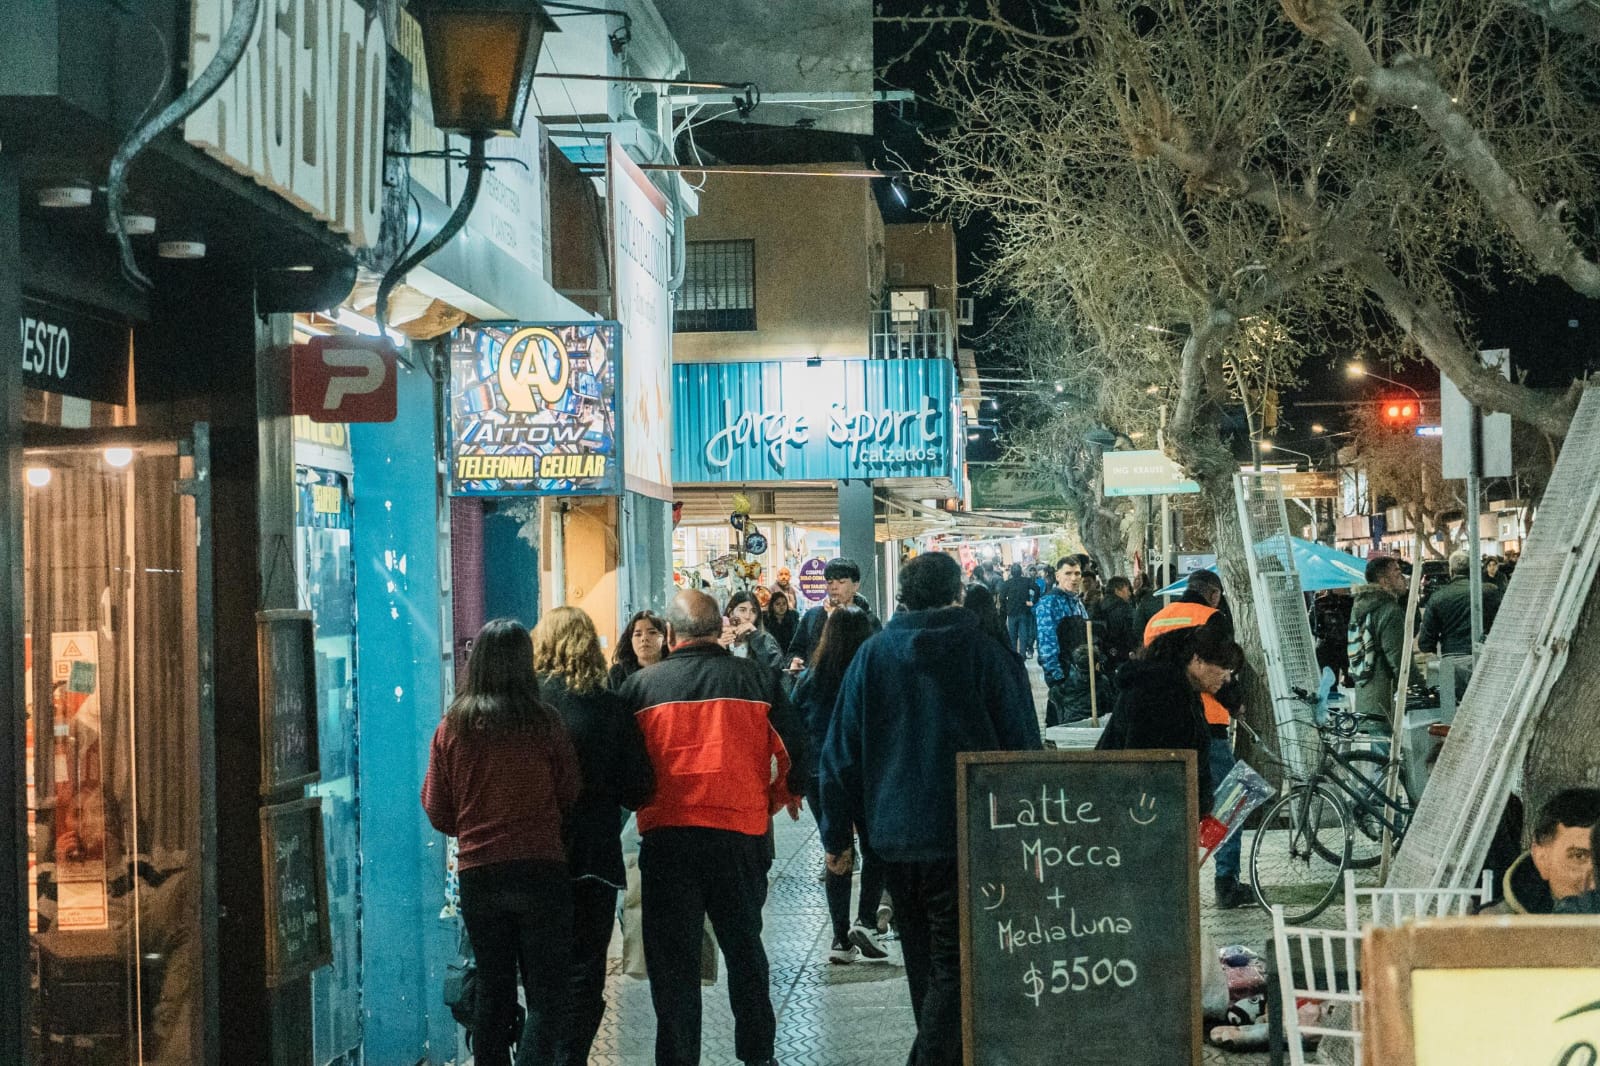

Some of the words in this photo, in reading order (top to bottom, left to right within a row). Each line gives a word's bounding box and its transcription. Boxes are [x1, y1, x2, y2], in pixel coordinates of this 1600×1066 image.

[20, 317, 70, 379] ESTO
[473, 424, 585, 443] Arrow
[706, 398, 809, 467] Jorge
[826, 396, 937, 462] Sport
[859, 447, 936, 463] calzados
[457, 456, 535, 479] TELEFONIA
[540, 455, 606, 477] CELULAR
[988, 784, 1101, 831] Latte
[1021, 837, 1122, 884] Mocca
[997, 907, 1132, 954] Medialuna
[1022, 957, 1138, 1007] $5500
